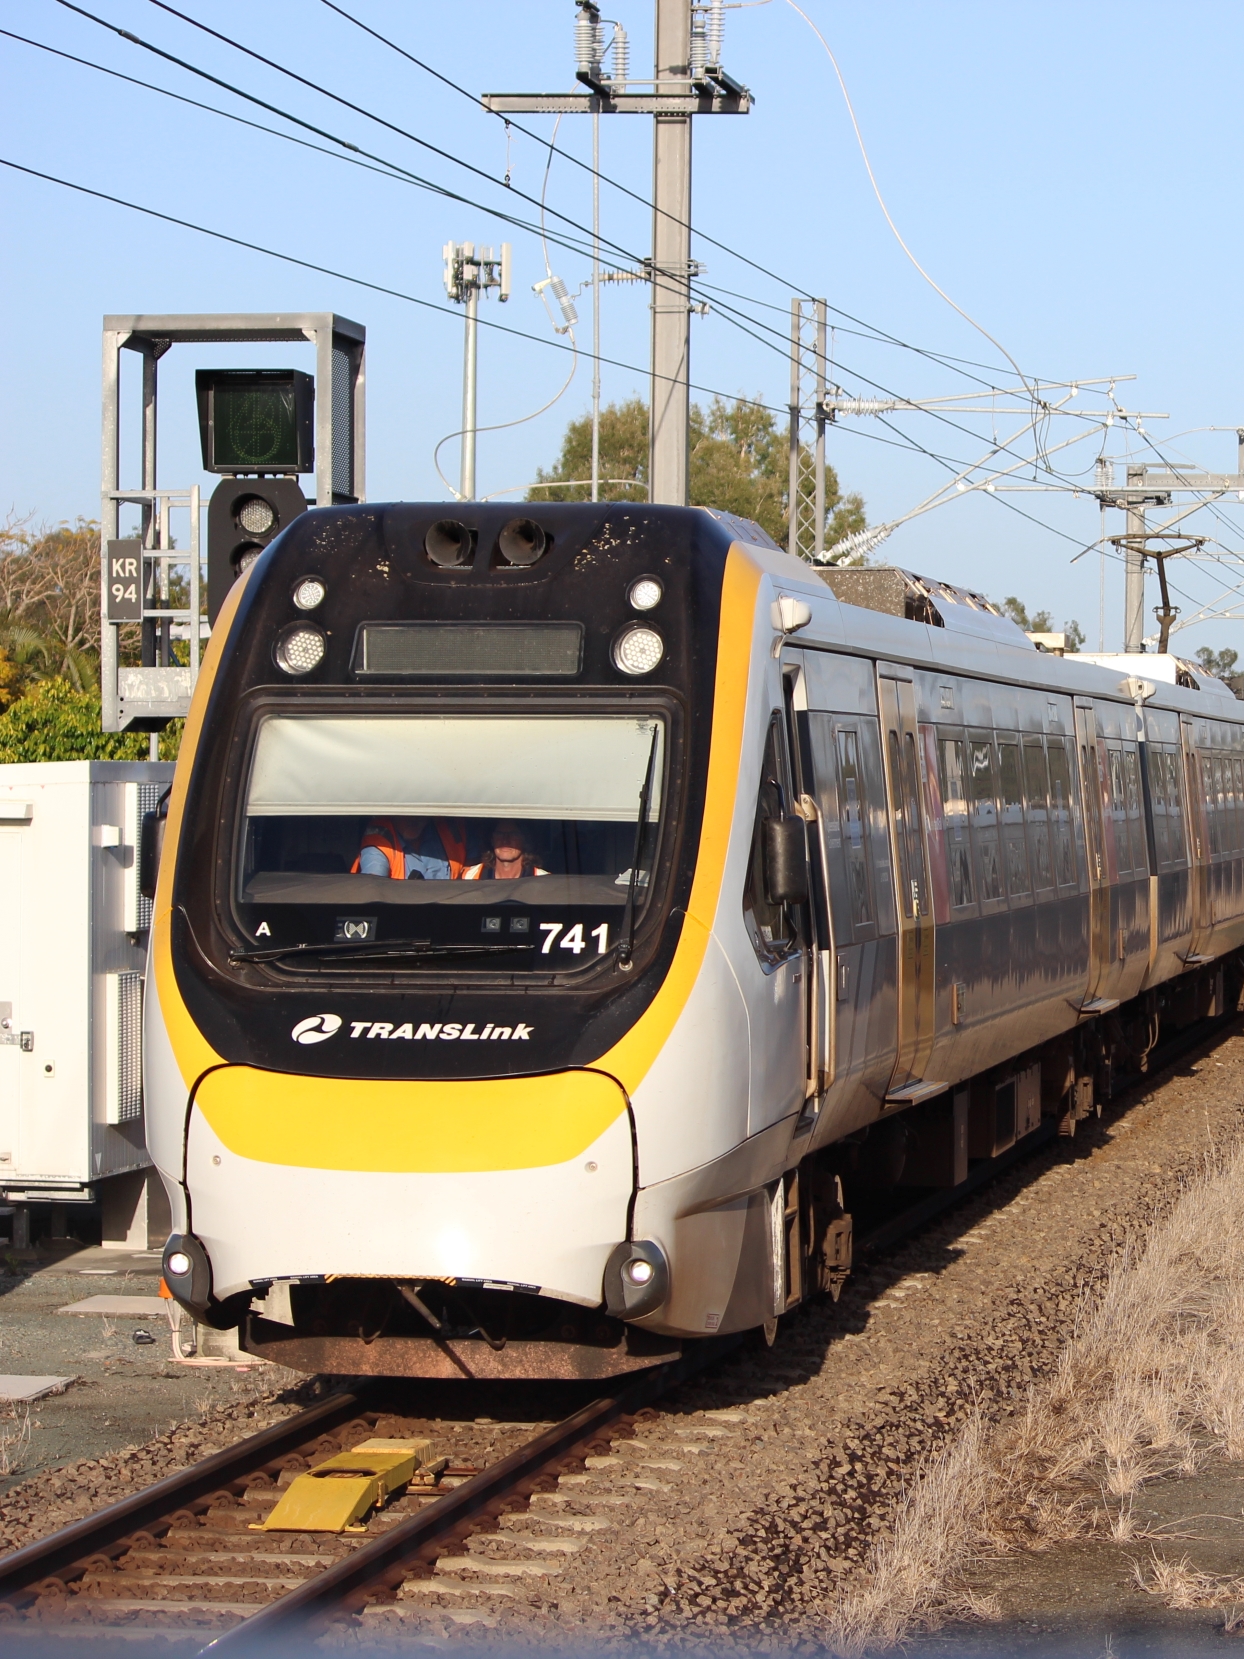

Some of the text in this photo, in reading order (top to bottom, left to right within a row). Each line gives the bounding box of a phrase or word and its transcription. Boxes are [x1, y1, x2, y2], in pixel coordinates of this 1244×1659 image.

[112, 558, 138, 578] KR
[111, 583, 138, 603] 94
[255, 921, 272, 937] A
[539, 923, 609, 954] 741
[349, 1021, 535, 1040] TRANSLink
